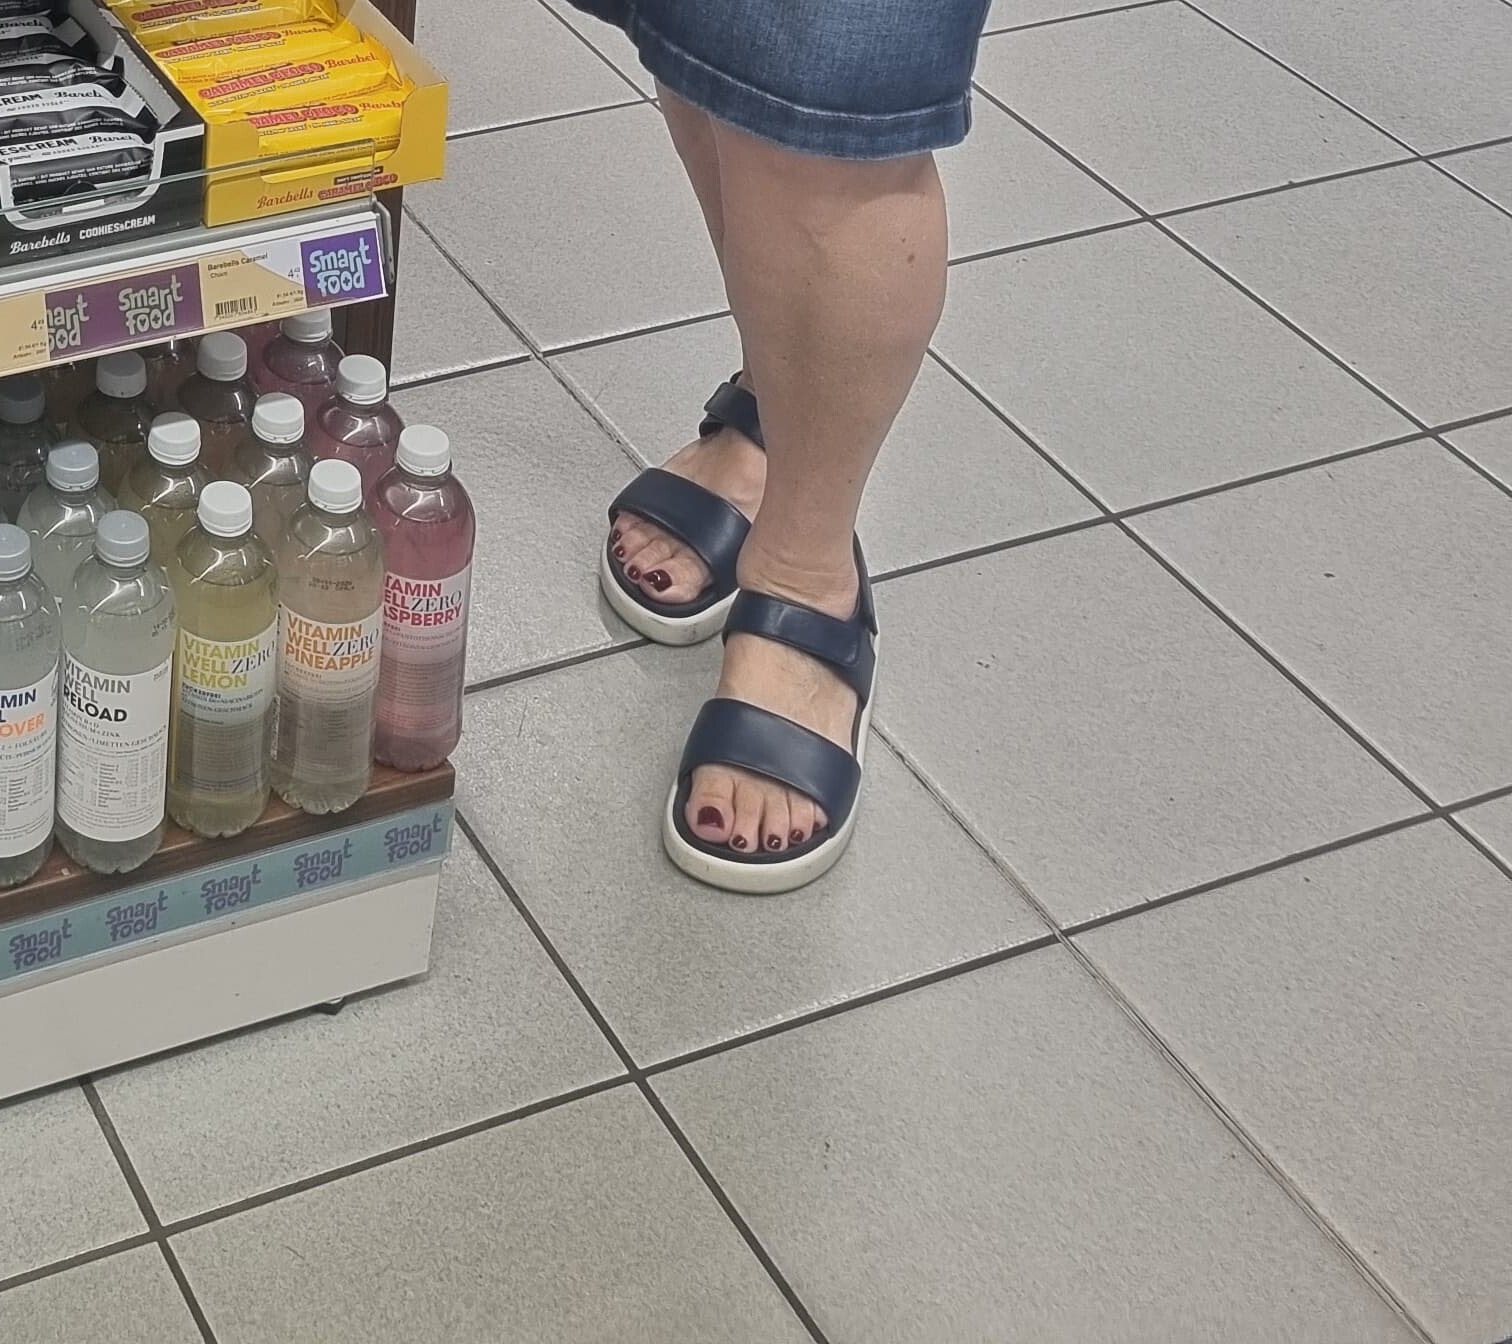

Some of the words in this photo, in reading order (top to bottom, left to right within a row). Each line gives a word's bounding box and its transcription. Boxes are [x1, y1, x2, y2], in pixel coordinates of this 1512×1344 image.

[10, 232, 71, 255] Barebells
[288, 612, 363, 640] VITAMIN
[184, 631, 259, 659] VITAMIN
[288, 629, 333, 656] WELL
[332, 628, 380, 657] ZERO
[185, 652, 231, 675] WELL
[230, 641, 277, 675] ZERO
[285, 645, 376, 671] PINEAPPLE
[183, 669, 248, 689] LEMON
[63, 687, 128, 723] RELOAD
